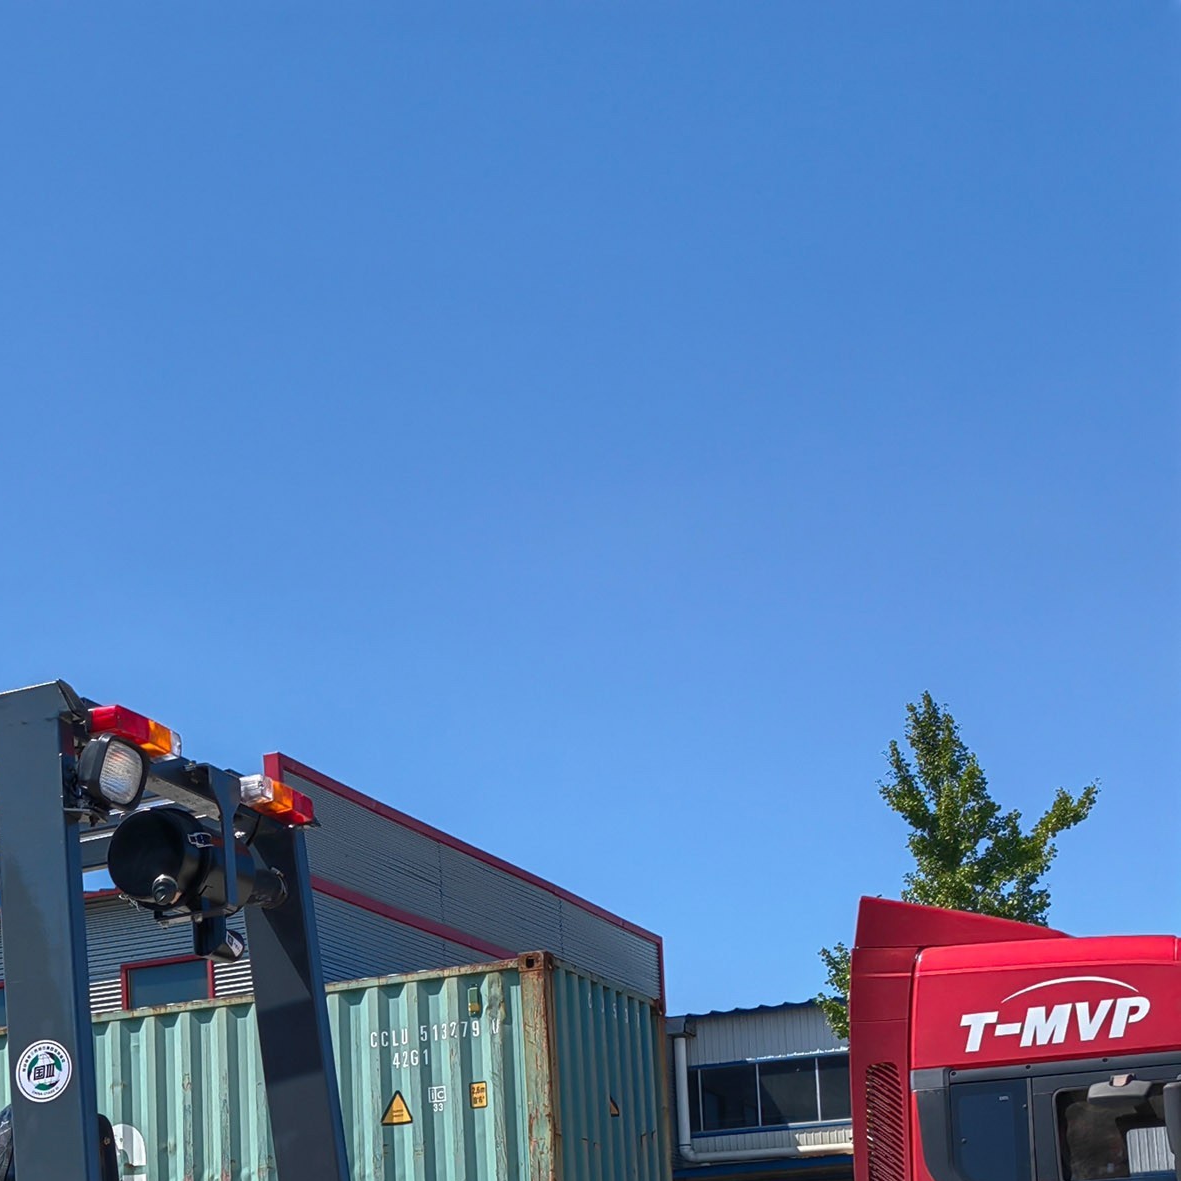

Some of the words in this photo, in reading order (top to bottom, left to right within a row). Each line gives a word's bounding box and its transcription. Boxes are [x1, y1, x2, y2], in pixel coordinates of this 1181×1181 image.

[370, 1028, 409, 1048] CCLU
[420, 1020, 480, 1042] 513279
[960, 996, 1151, 1053] T-MVP
[392, 1049, 429, 1069] 42G1
[432, 1103, 444, 1112] 33
